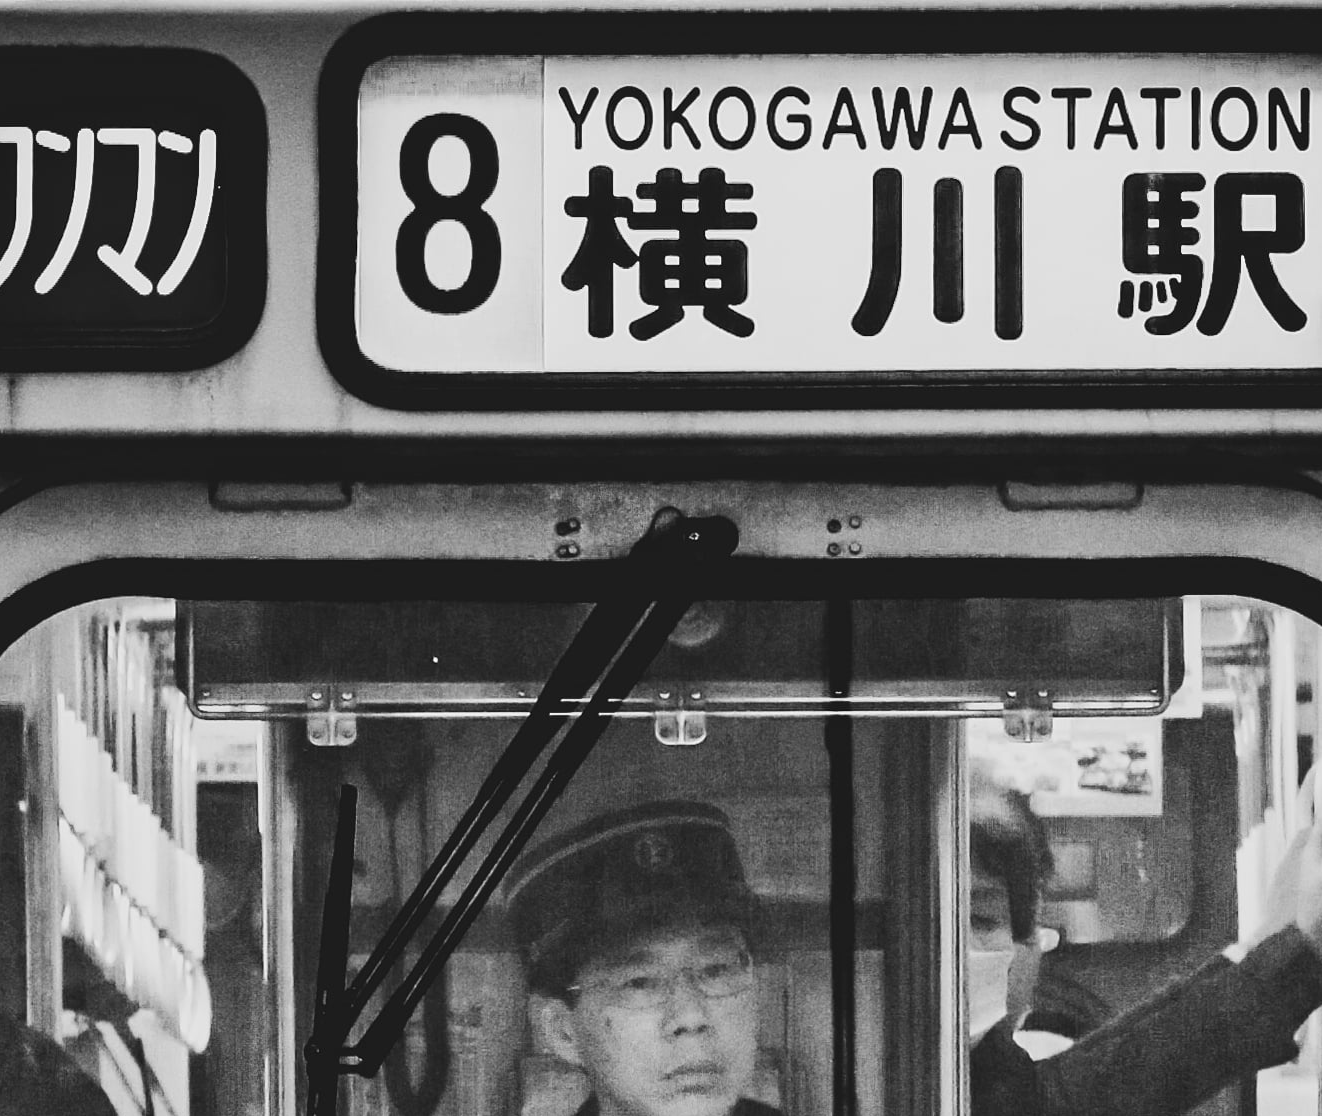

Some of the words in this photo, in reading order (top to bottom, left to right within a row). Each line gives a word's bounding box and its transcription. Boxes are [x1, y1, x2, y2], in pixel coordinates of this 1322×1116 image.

[558, 86, 982, 151] YOKOGAWA
[1000, 86, 1310, 151] STATION
[395, 112, 502, 315] 8
[561, 164, 1307, 341] 横川駅
